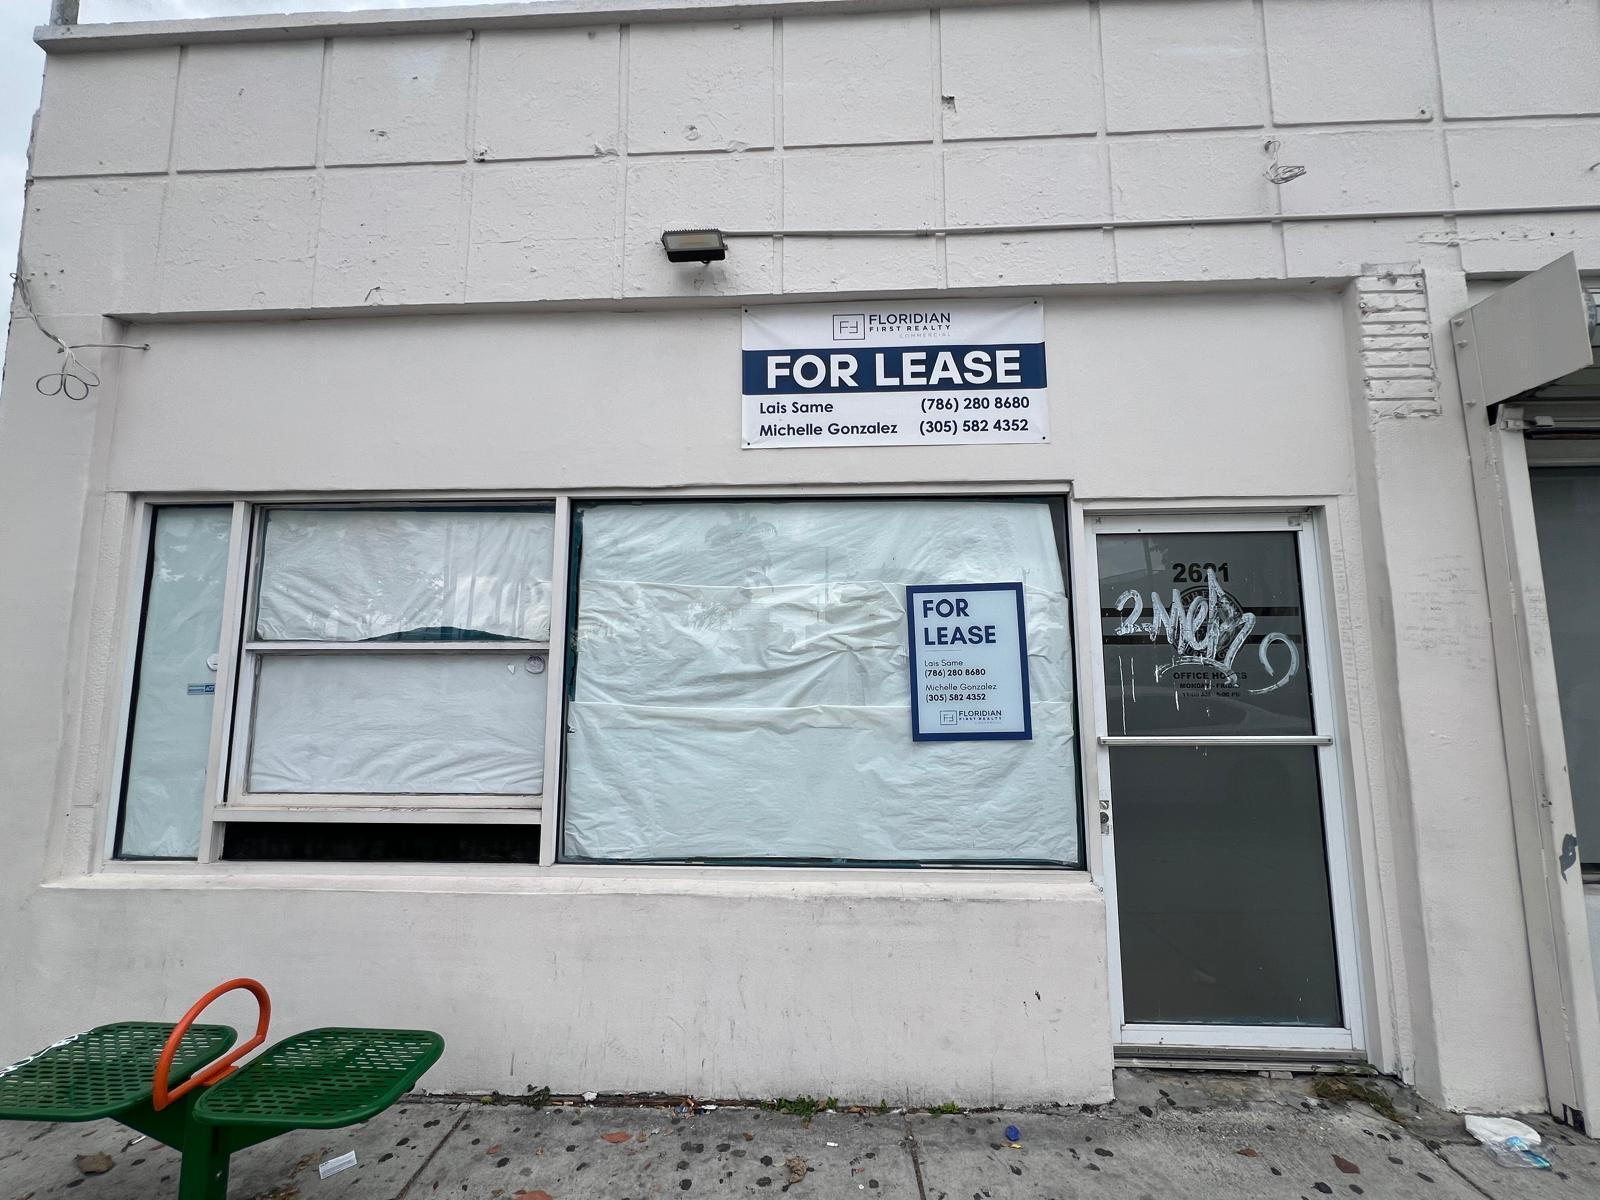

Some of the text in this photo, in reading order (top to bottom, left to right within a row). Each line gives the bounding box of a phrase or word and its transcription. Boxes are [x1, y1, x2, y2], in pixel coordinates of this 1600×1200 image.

[869, 313, 951, 325] FLORIDIAN
[767, 350, 1022, 388] FOR LEASE
[760, 401, 834, 414] Lais Same
[921, 396, 1030, 413] (786) 280 8680
[759, 421, 898, 437] Michelle Gonzalez
[919, 419, 1029, 435] (305) 582 4352
[922, 598, 970, 618] FOR
[924, 625, 996, 645] LEASE
[941, 659, 964, 667] Same
[924, 669, 946, 678] (786)
[965, 668, 986, 676] 8680
[925, 682, 997, 691] Michelle Gonzalez
[925, 693, 986, 703] (305) 582 4352
